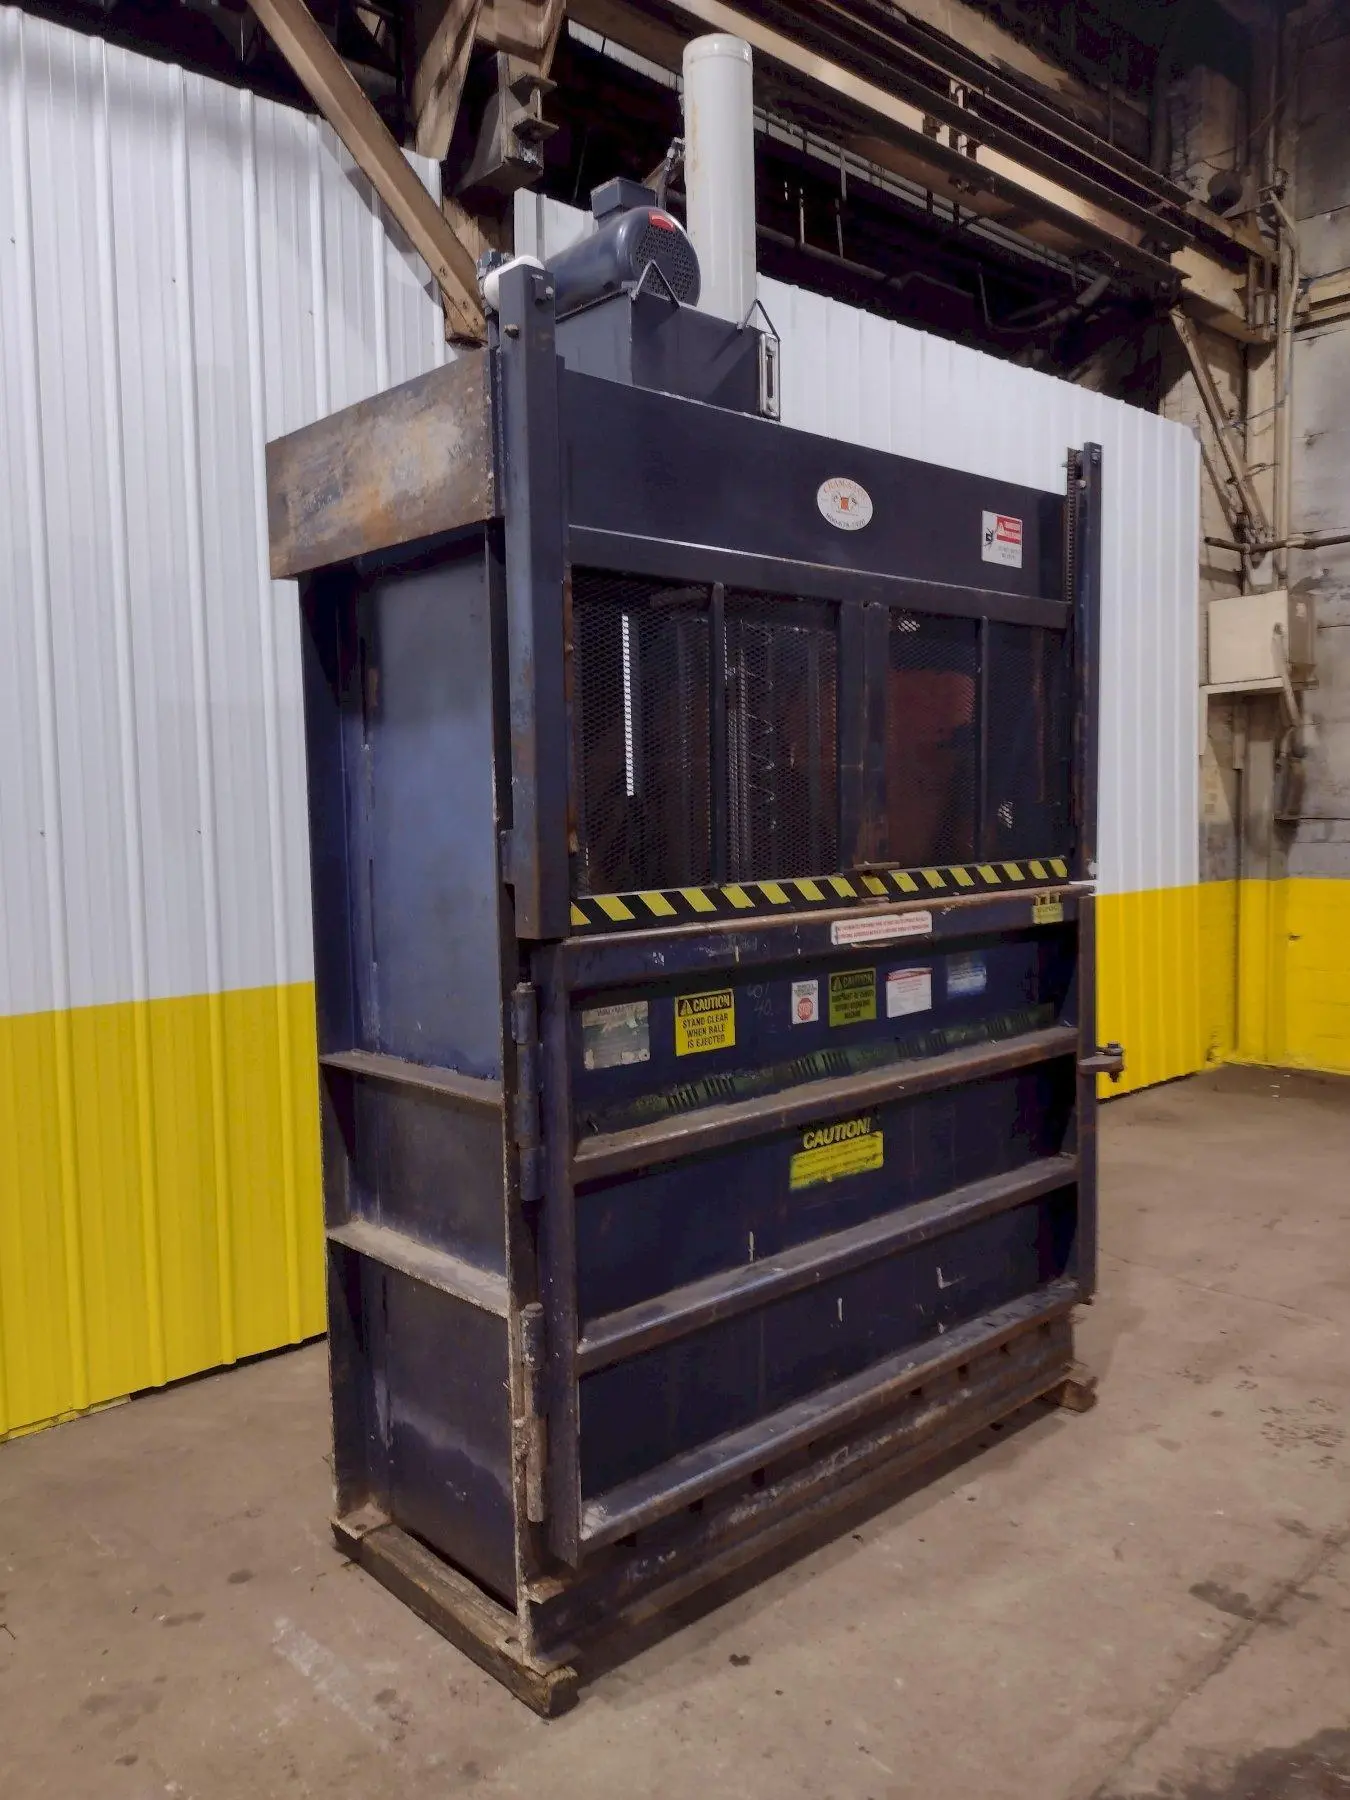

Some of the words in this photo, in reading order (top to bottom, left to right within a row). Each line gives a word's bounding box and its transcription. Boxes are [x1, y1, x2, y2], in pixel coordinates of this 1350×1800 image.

[843, 973, 873, 988] CAUTION
[692, 994, 730, 1012] CAUTION
[682, 1017, 706, 1029] STAND
[707, 1012, 729, 1024] CLEAR
[686, 1027, 707, 1038] WHEN
[708, 1023, 726, 1034] BALE
[687, 1040, 694, 1049] IS
[696, 1034, 726, 1047] EJECTED
[803, 1117, 871, 1150] CAUTION!
